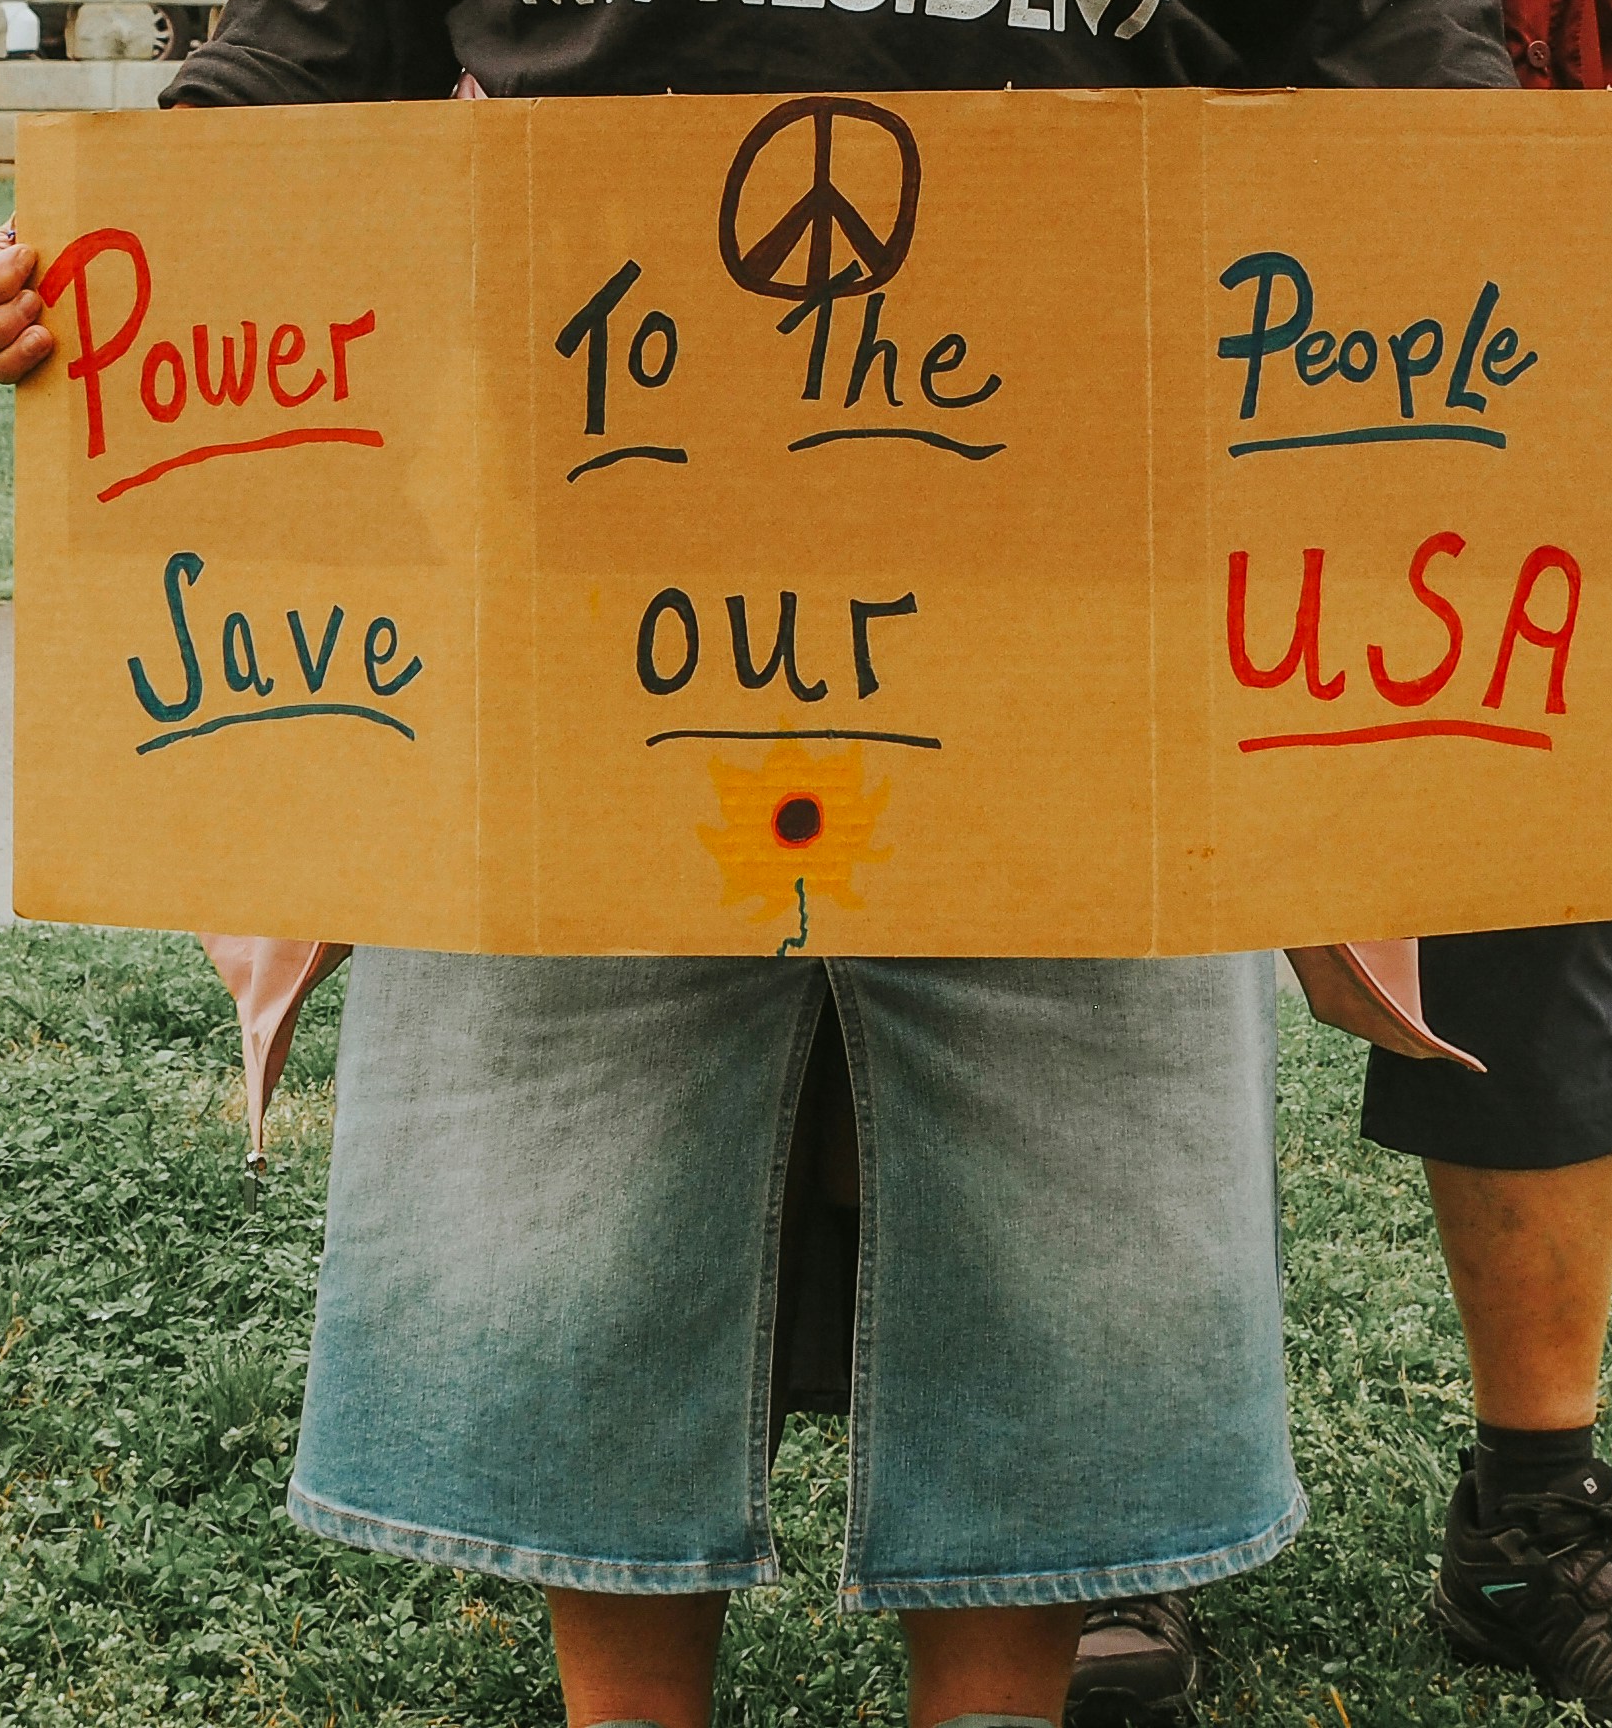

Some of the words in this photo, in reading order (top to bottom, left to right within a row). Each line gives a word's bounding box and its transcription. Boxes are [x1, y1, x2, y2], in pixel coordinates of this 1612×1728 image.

[39, 227, 376, 460] Power
[554, 259, 680, 436] To
[775, 259, 1003, 410] The
[127, 551, 424, 723] Save
[1226, 530, 1583, 717] USA
